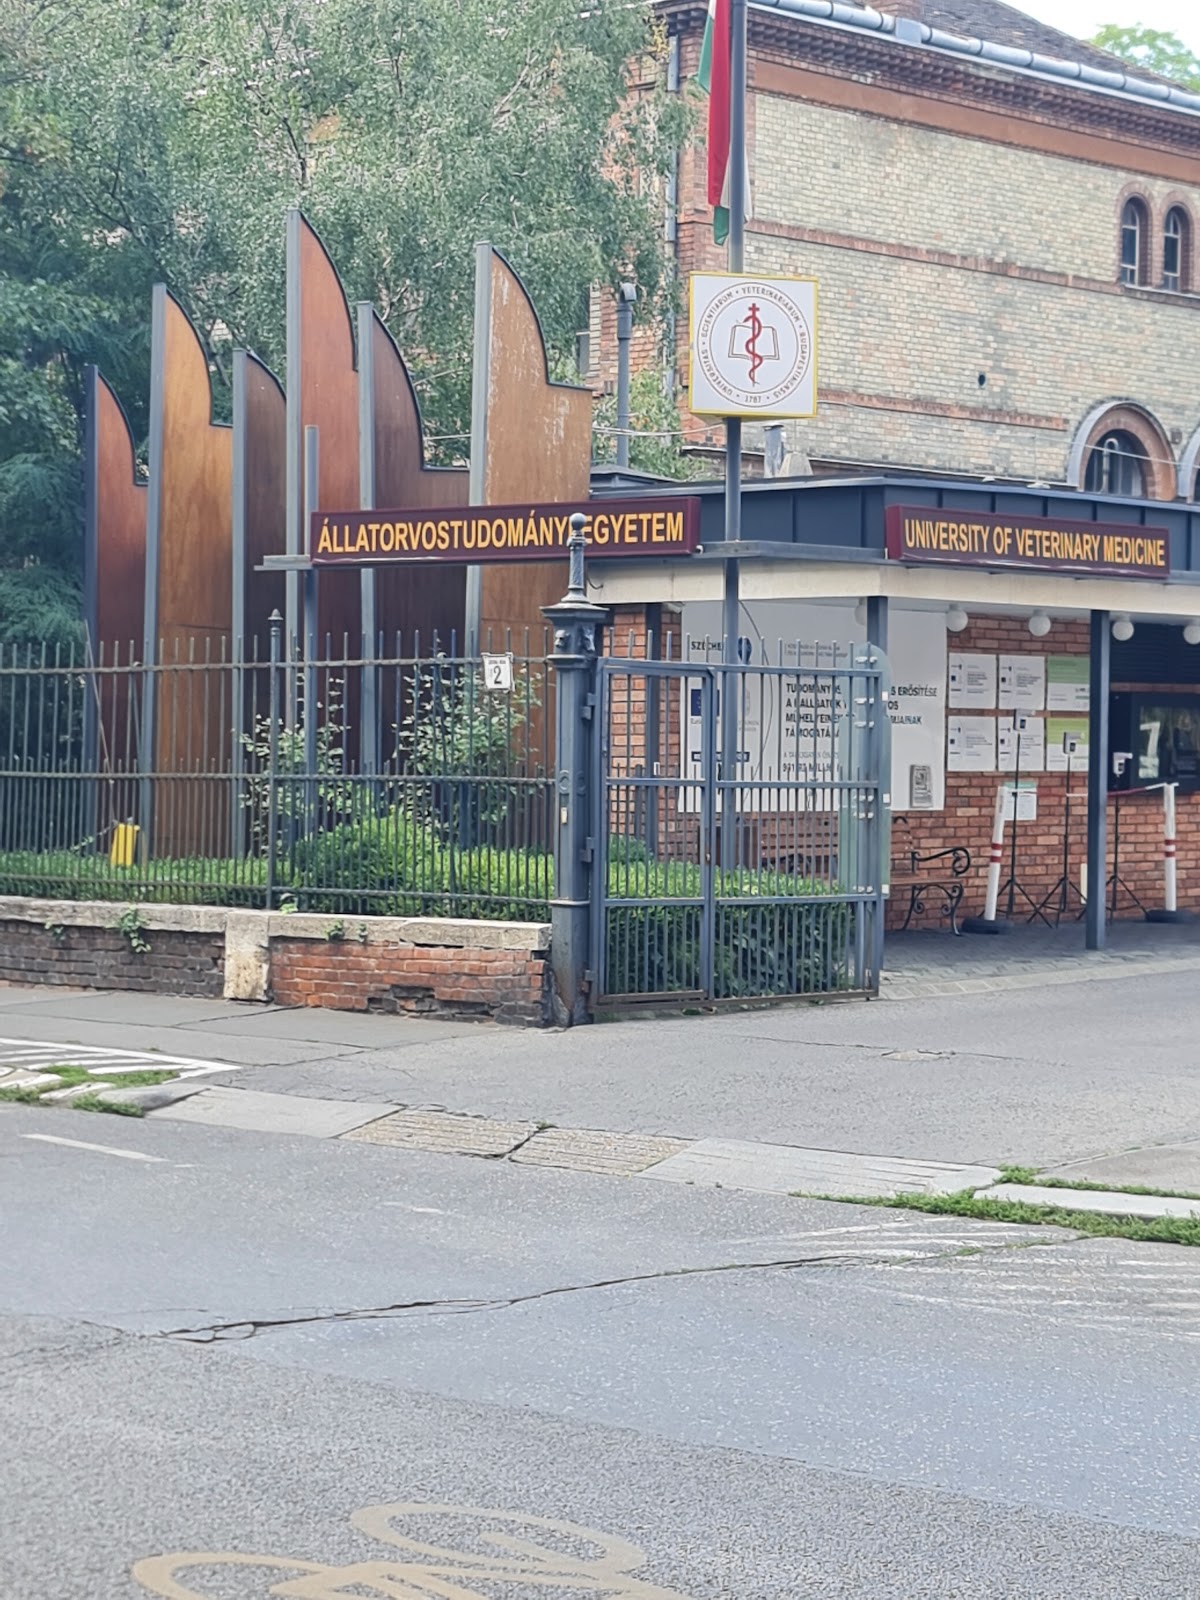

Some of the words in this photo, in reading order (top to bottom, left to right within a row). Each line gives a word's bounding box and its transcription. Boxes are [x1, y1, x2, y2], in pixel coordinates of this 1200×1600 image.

[584, 511, 683, 545] EGYETEM
[904, 518, 991, 554] UNIVERSITY
[993, 526, 1012, 555] OF
[1014, 528, 1101, 562] VETERINARY
[1103, 535, 1166, 567] MEDICINE
[493, 665, 502, 685] 2
